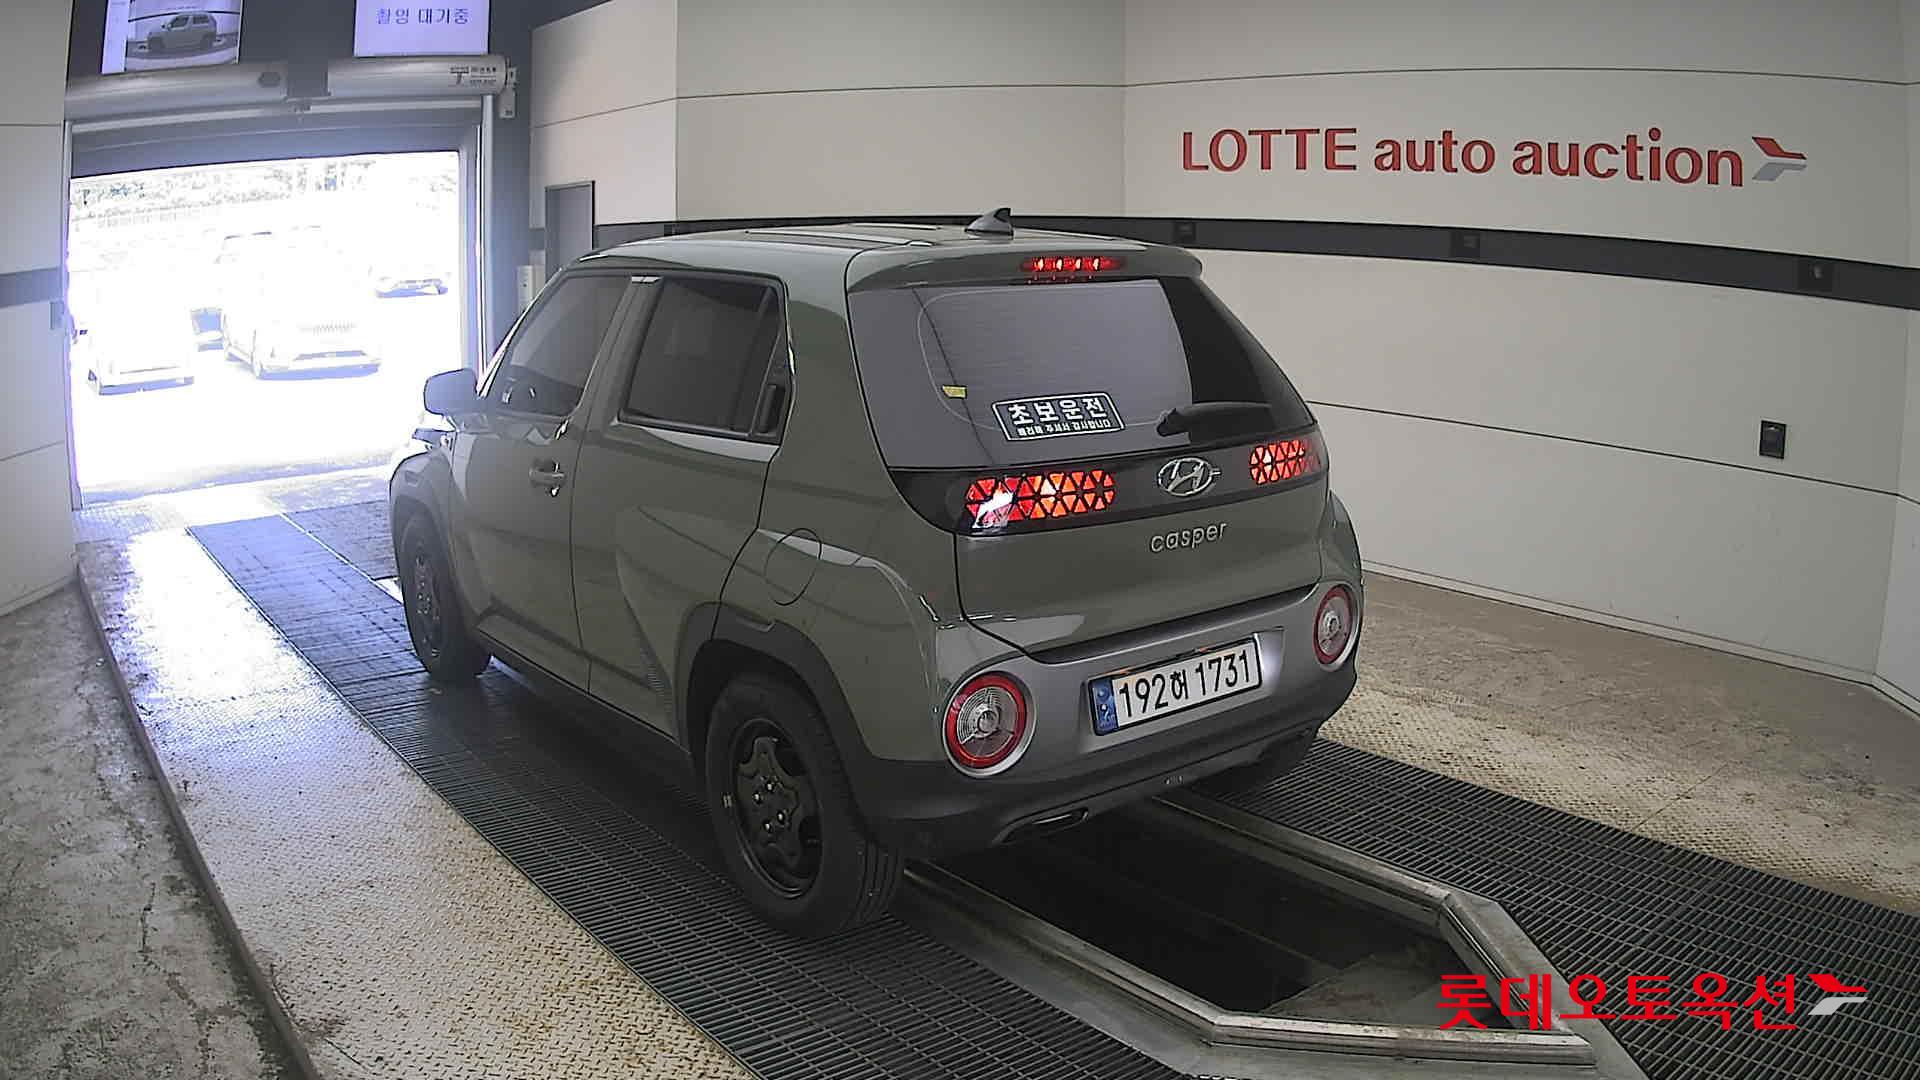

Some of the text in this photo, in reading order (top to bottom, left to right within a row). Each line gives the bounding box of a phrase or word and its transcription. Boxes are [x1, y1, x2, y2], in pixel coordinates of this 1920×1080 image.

[418, 8, 470, 25] 대기중
[1182, 127, 1744, 187] LOTTE auto auction
[1008, 397, 1107, 426] 초보운전
[1151, 523, 1227, 552] casper
[1119, 649, 1250, 717] 192허 1731
